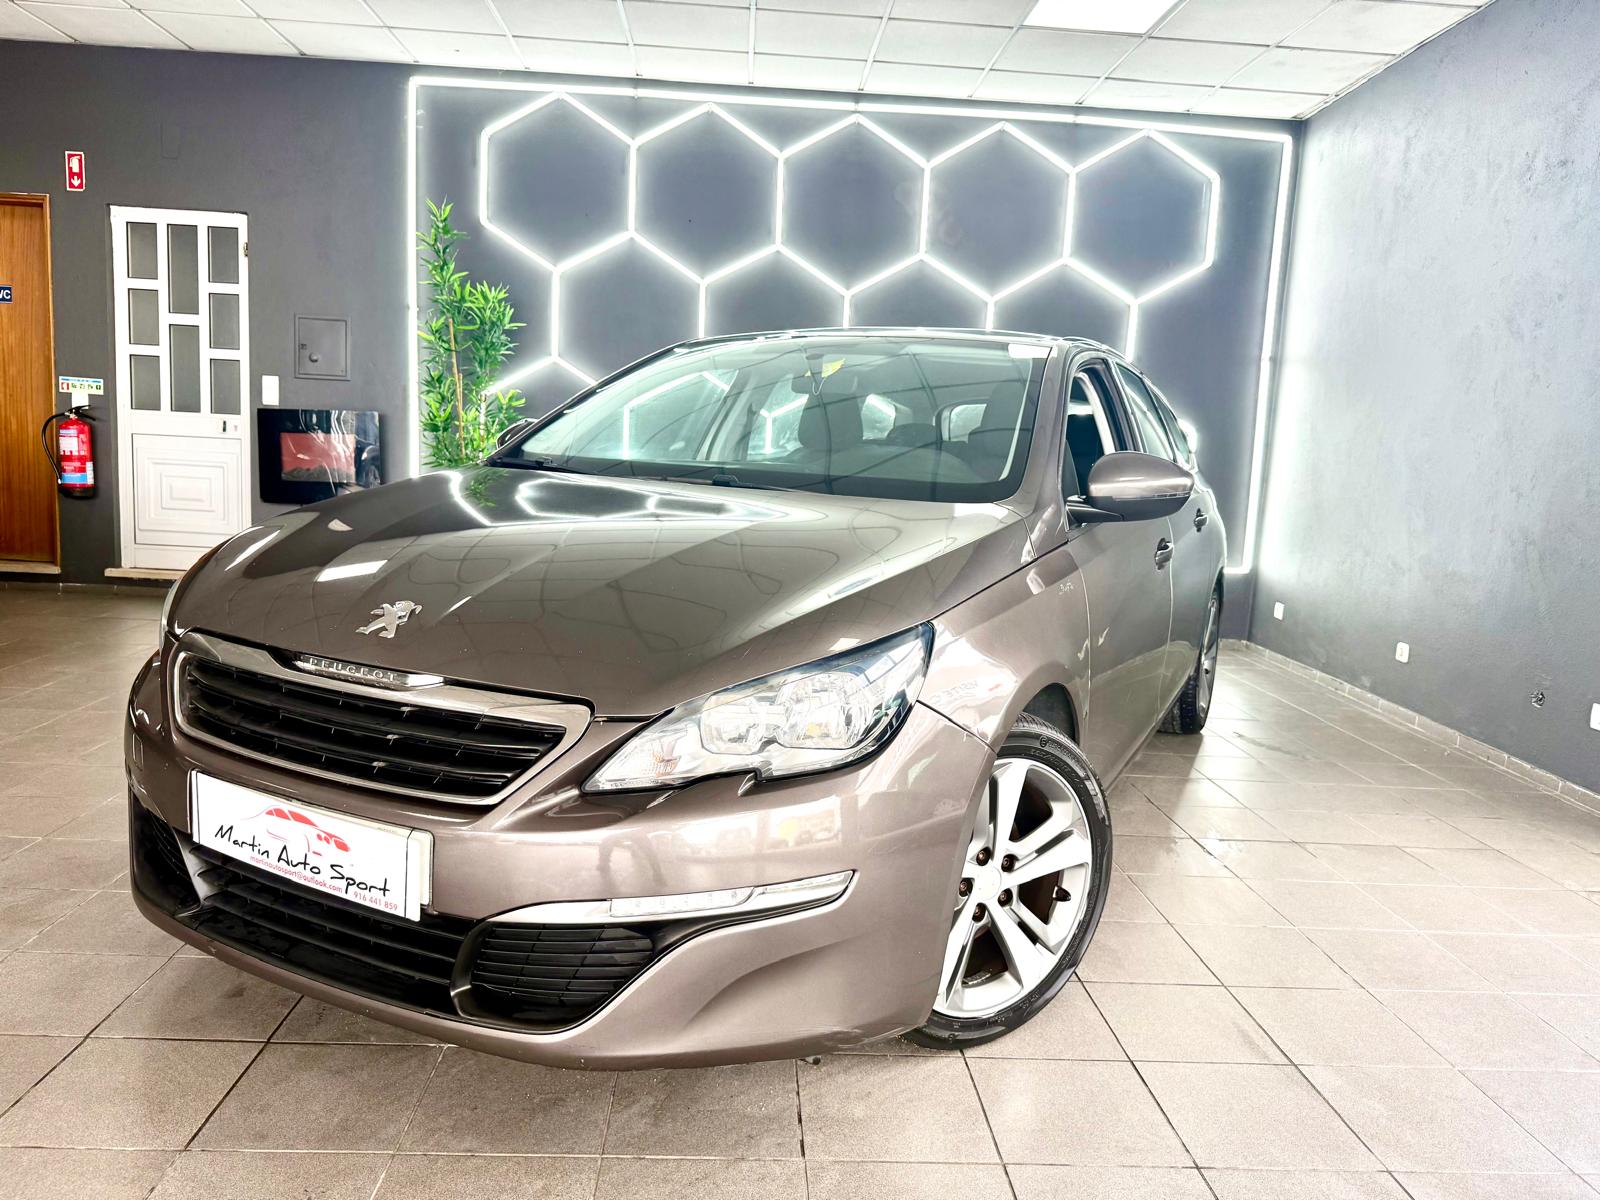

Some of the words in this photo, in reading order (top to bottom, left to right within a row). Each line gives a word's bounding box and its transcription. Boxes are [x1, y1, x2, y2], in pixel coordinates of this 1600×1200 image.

[309, 656, 398, 682] PEUGEOT
[214, 824, 270, 859] Martin
[277, 844, 322, 875] Auto
[330, 864, 391, 897] Sport
[353, 891, 367, 902] 916
[369, 896, 382, 906] 441
[384, 901, 398, 912] 859
